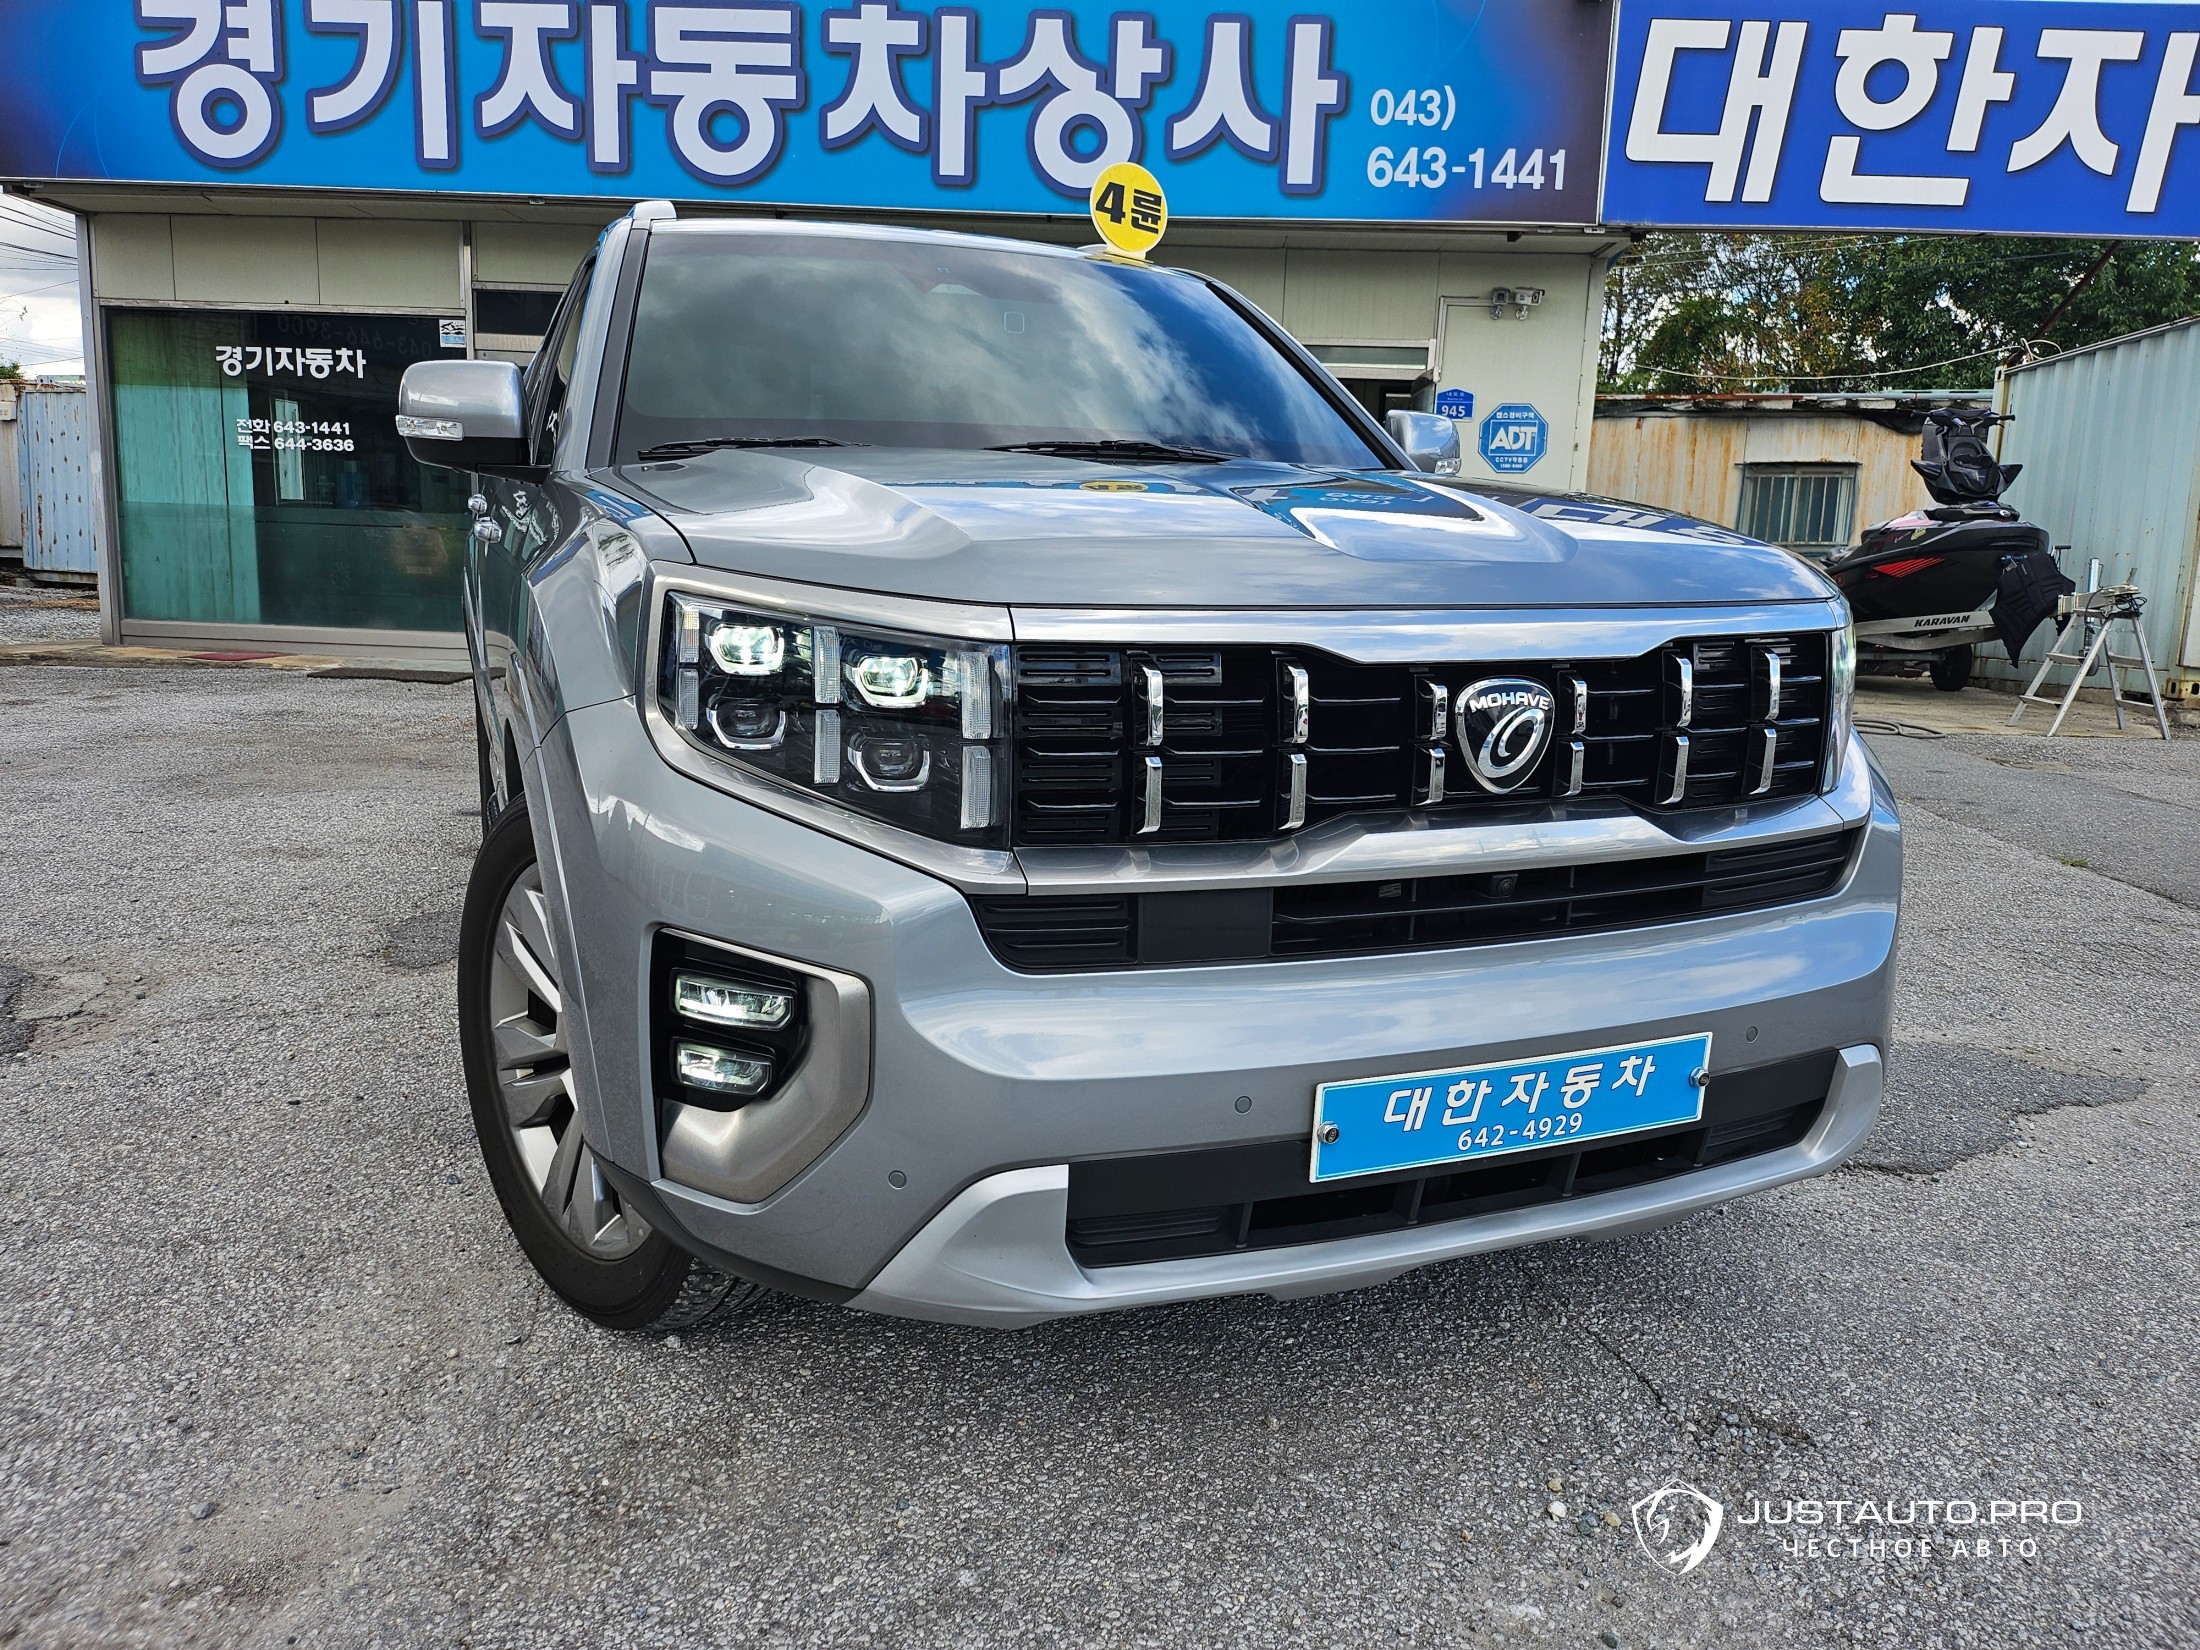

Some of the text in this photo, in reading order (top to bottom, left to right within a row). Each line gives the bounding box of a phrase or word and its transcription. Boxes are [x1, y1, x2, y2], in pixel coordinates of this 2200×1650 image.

[138, 0, 1342, 192] 경기자동차상사
[1369, 84, 1456, 130] 043)
[1625, 13, 2200, 213] 대한자
[1366, 146, 1567, 191] 643-1441
[1095, 181, 1163, 235] 4륜
[215, 345, 367, 379] 경기자동차
[236, 418, 351, 435] 전화 643-1441
[1441, 405, 1466, 417] 945
[237, 435, 355, 452] 팩스 644-3636
[1489, 426, 1537, 450] ADT
[1914, 615, 1970, 628] KARAVAN
[1469, 691, 1550, 713] MOHAVE
[1457, 1113, 1584, 1151] 642-4929
